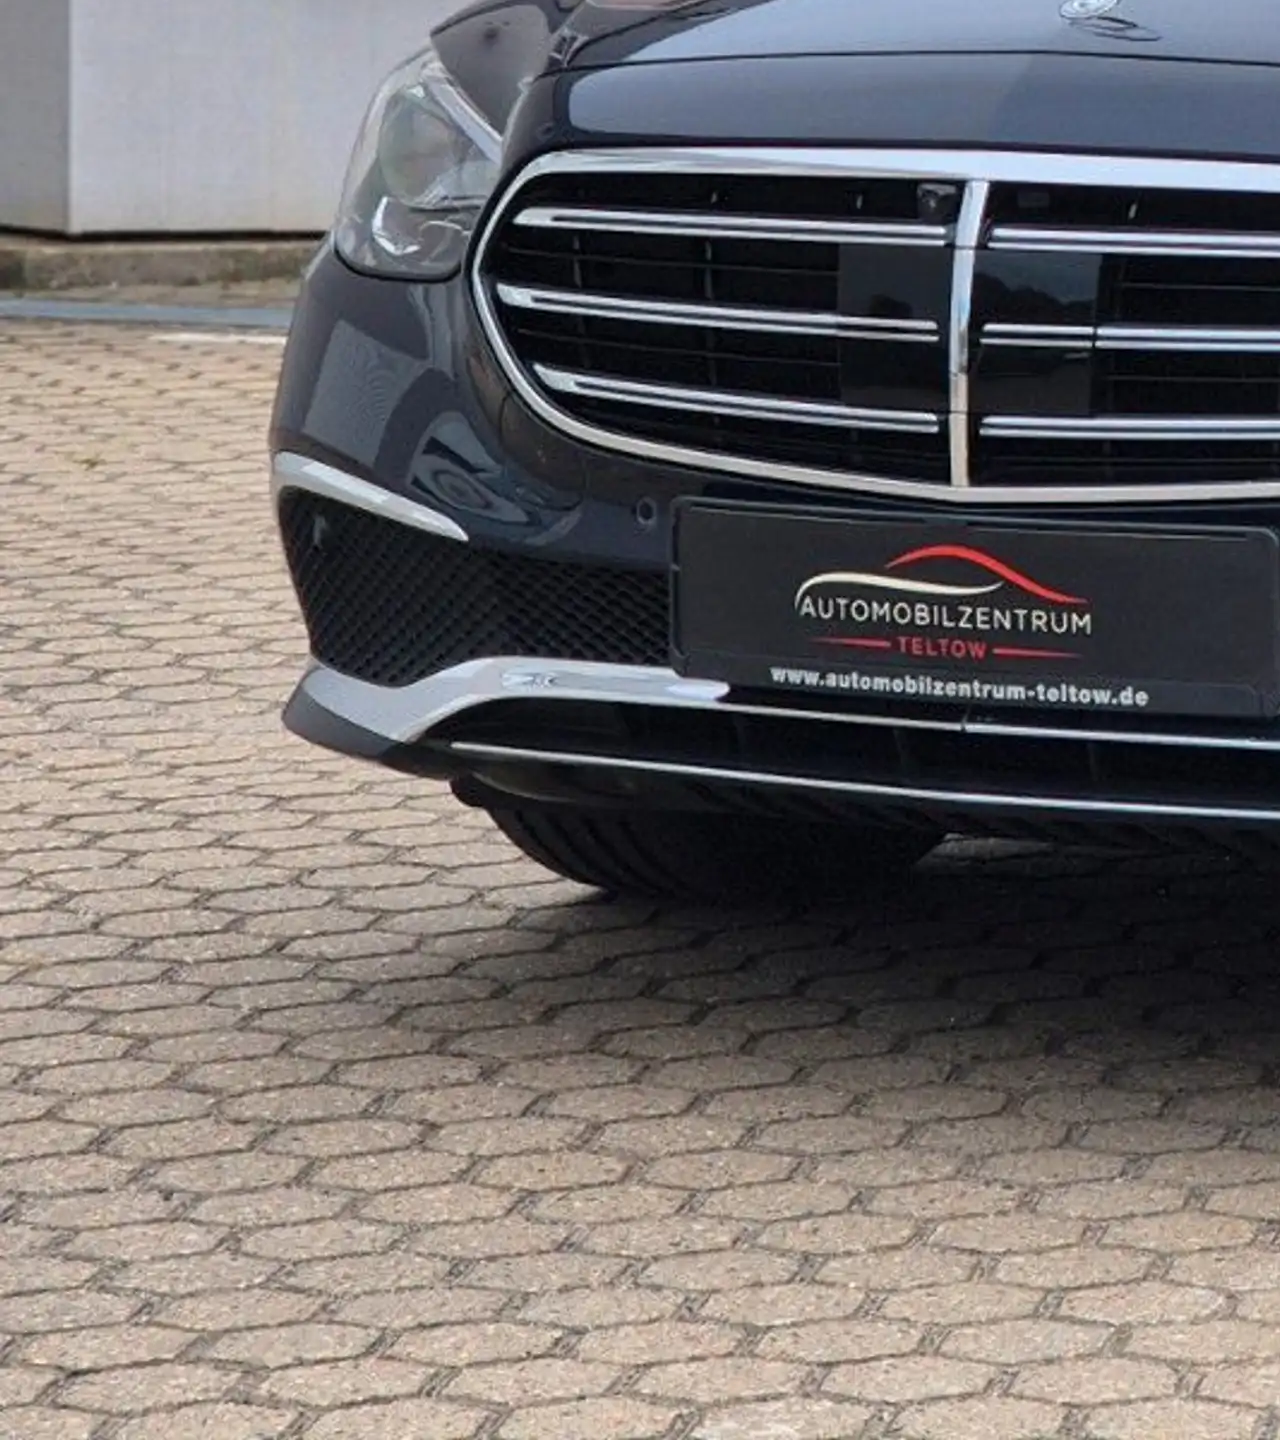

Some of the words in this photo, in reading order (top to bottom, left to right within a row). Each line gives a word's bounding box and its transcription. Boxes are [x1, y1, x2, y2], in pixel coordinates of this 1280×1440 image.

[800, 594, 1092, 636] AUTOMOBILZENTRUM
[897, 635, 987, 660] TELTOW
[770, 665, 1150, 708] www.automobilzentrum-teltow.de
